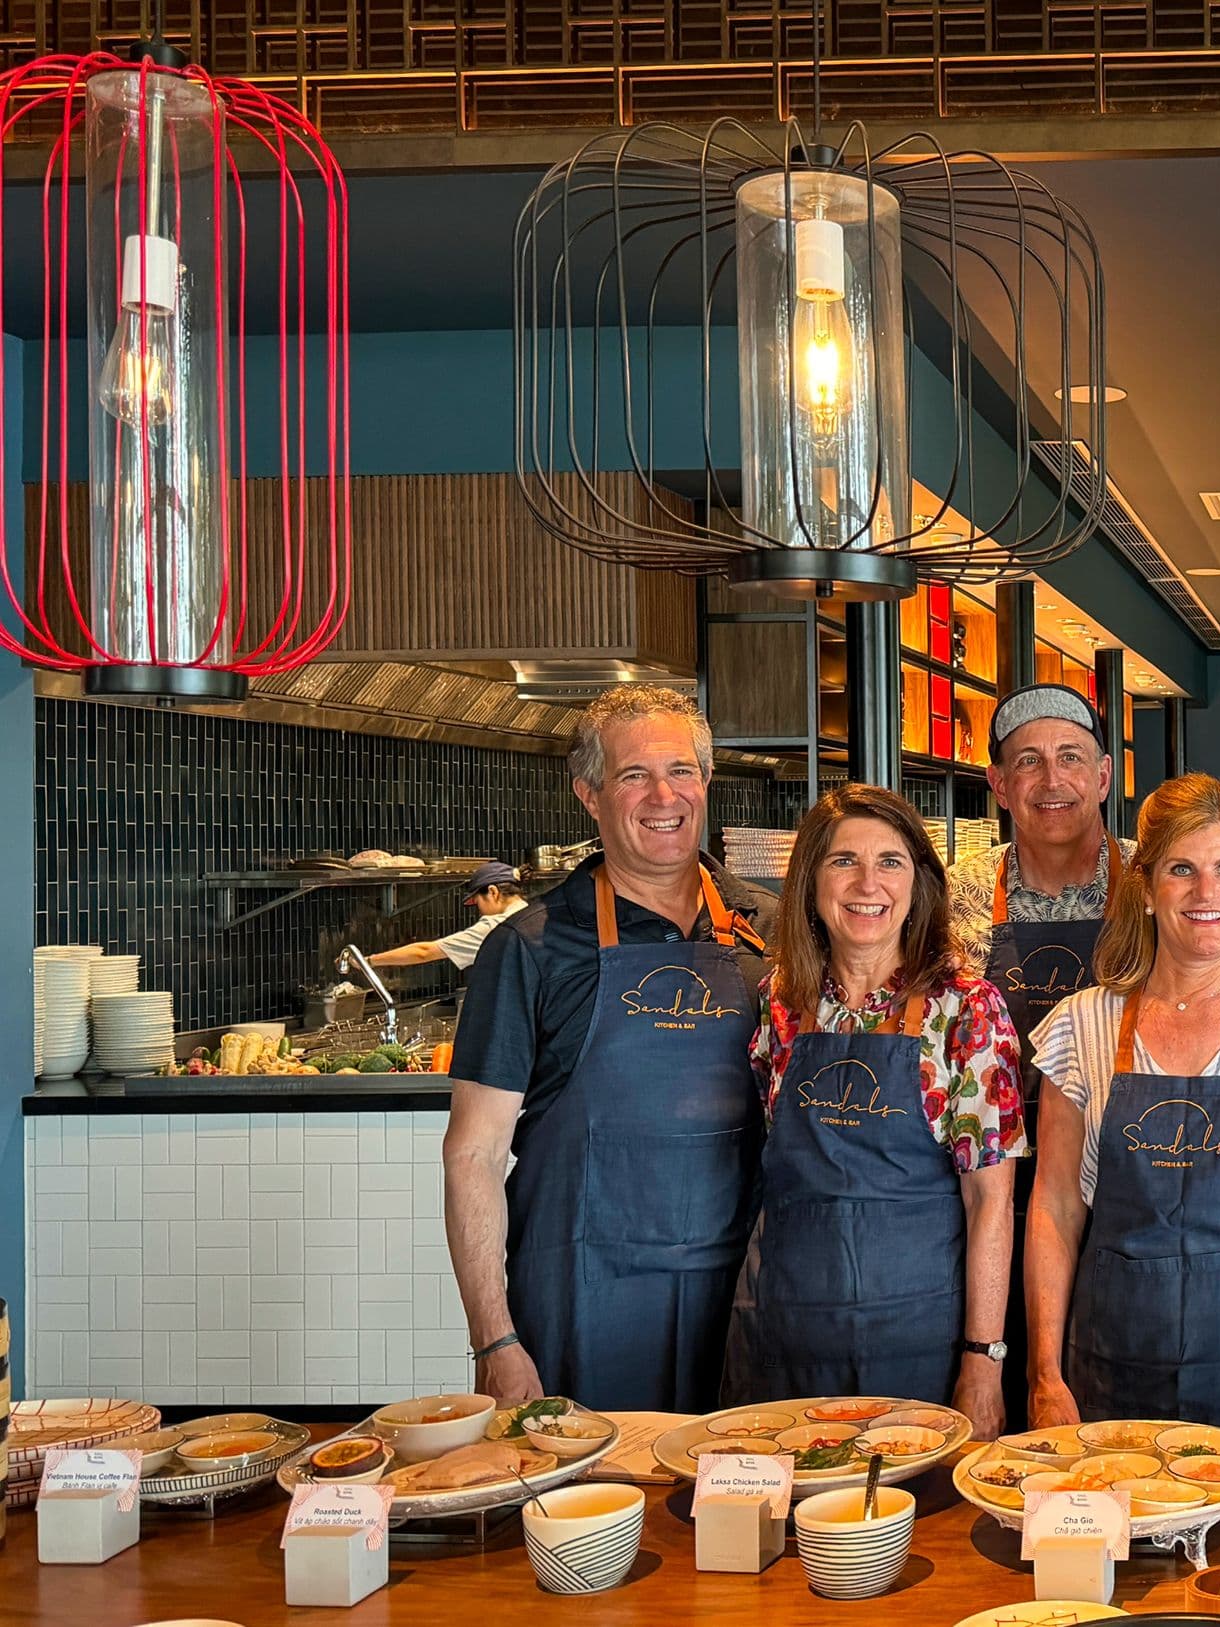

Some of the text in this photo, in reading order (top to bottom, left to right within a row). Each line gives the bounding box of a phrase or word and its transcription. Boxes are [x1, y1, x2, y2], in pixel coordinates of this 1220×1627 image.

[620, 988, 741, 1018] Sandals
[797, 1080, 908, 1118] Sandals
[46, 1472, 73, 1480] Vietnam
[732, 1478, 760, 1486] Chicken
[726, 1487, 745, 1495] Salad
[313, 1507, 343, 1515] Roasted
[1063, 1516, 1094, 1524] Cha Gio
